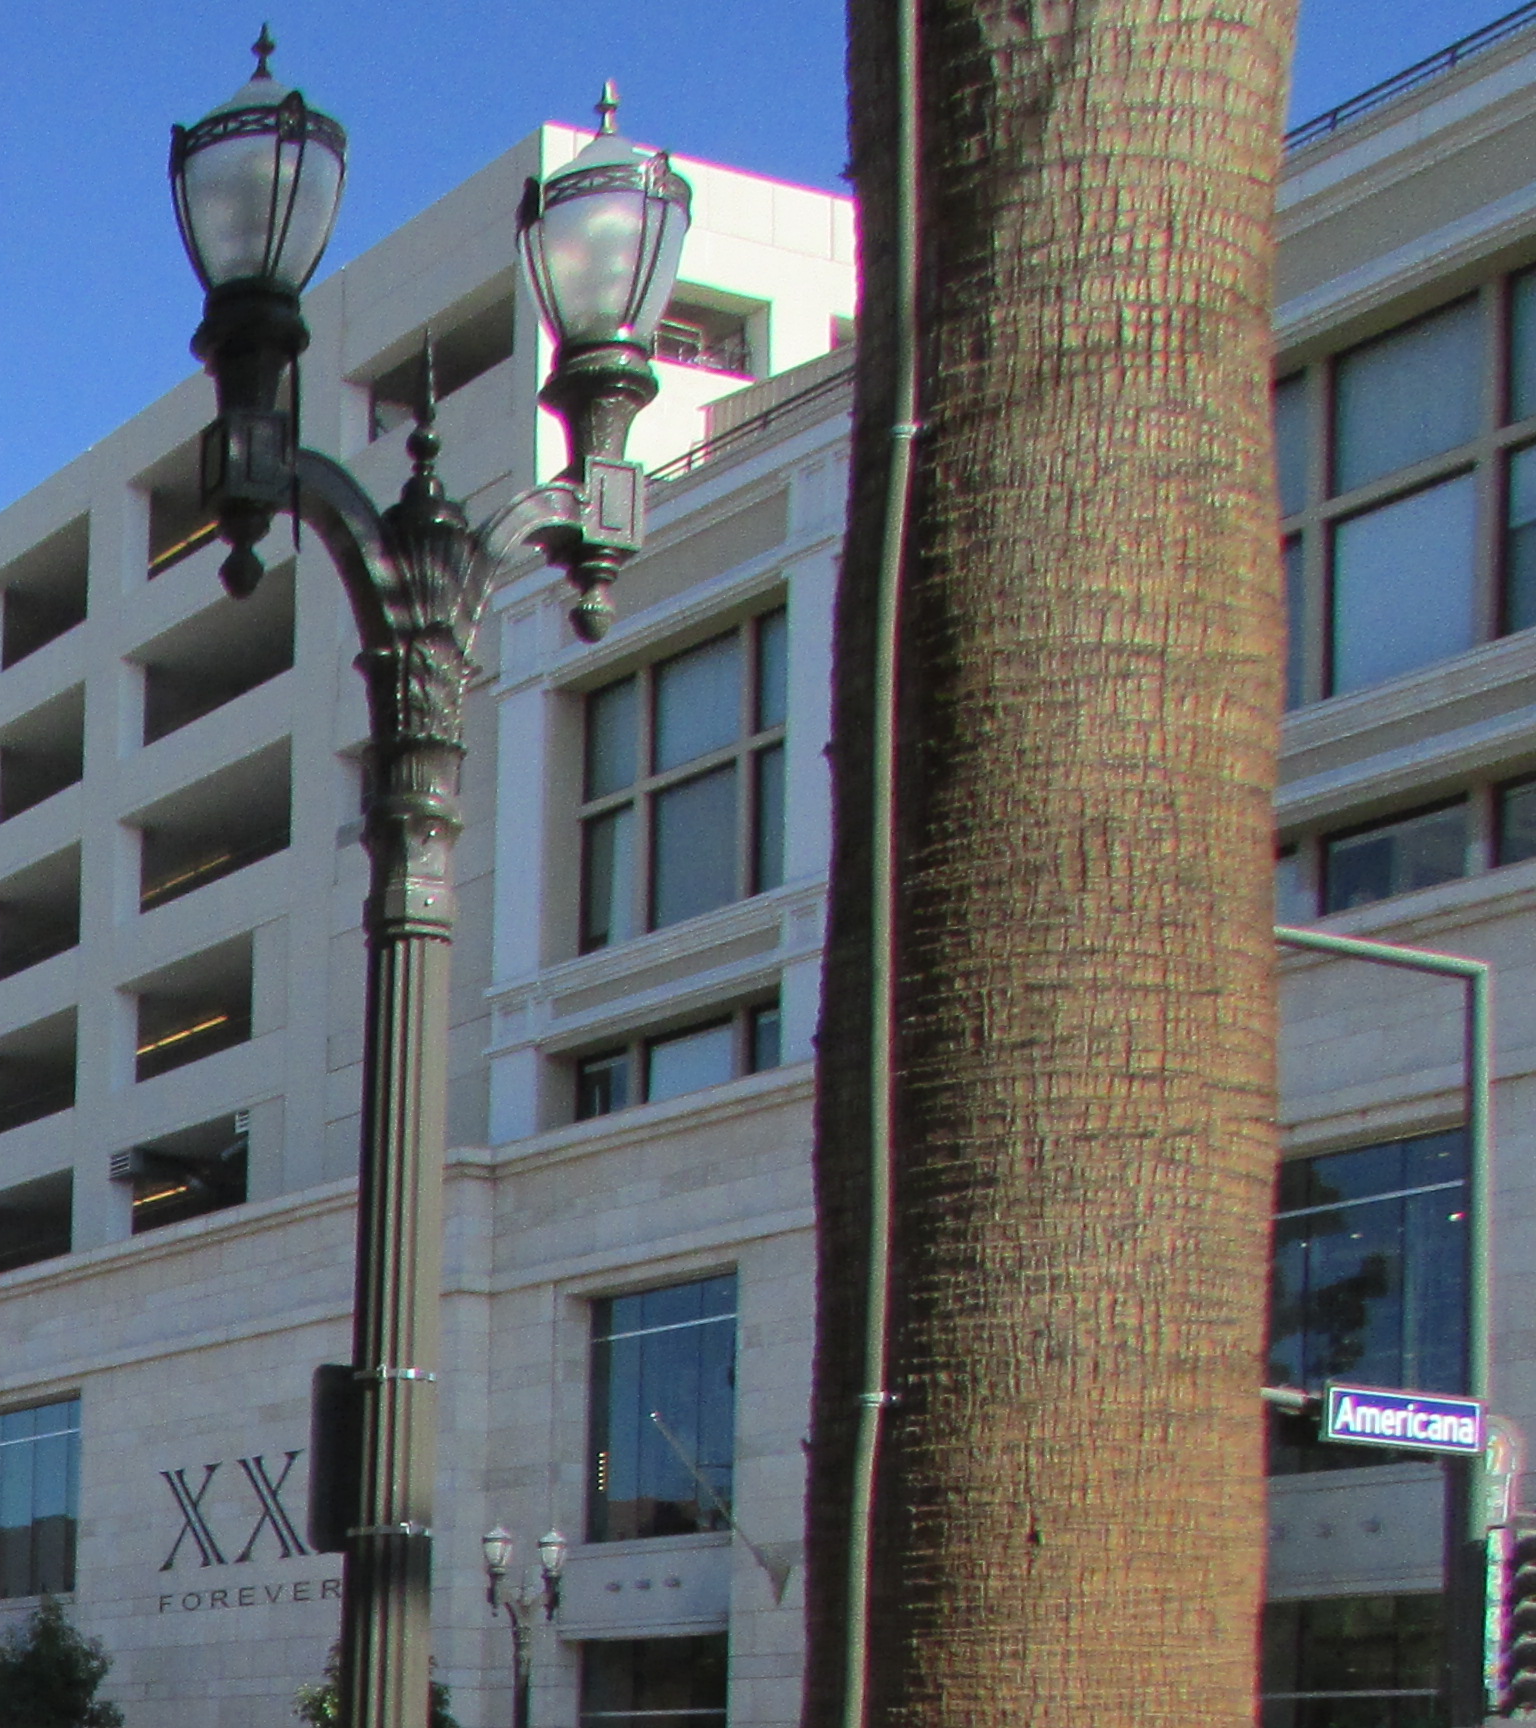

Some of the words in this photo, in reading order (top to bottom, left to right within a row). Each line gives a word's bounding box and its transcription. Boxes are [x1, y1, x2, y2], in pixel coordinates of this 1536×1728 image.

[1333, 1395, 1475, 1444] Americana
[158, 1447, 313, 1572] XX
[158, 1577, 343, 1614] FOREVER
